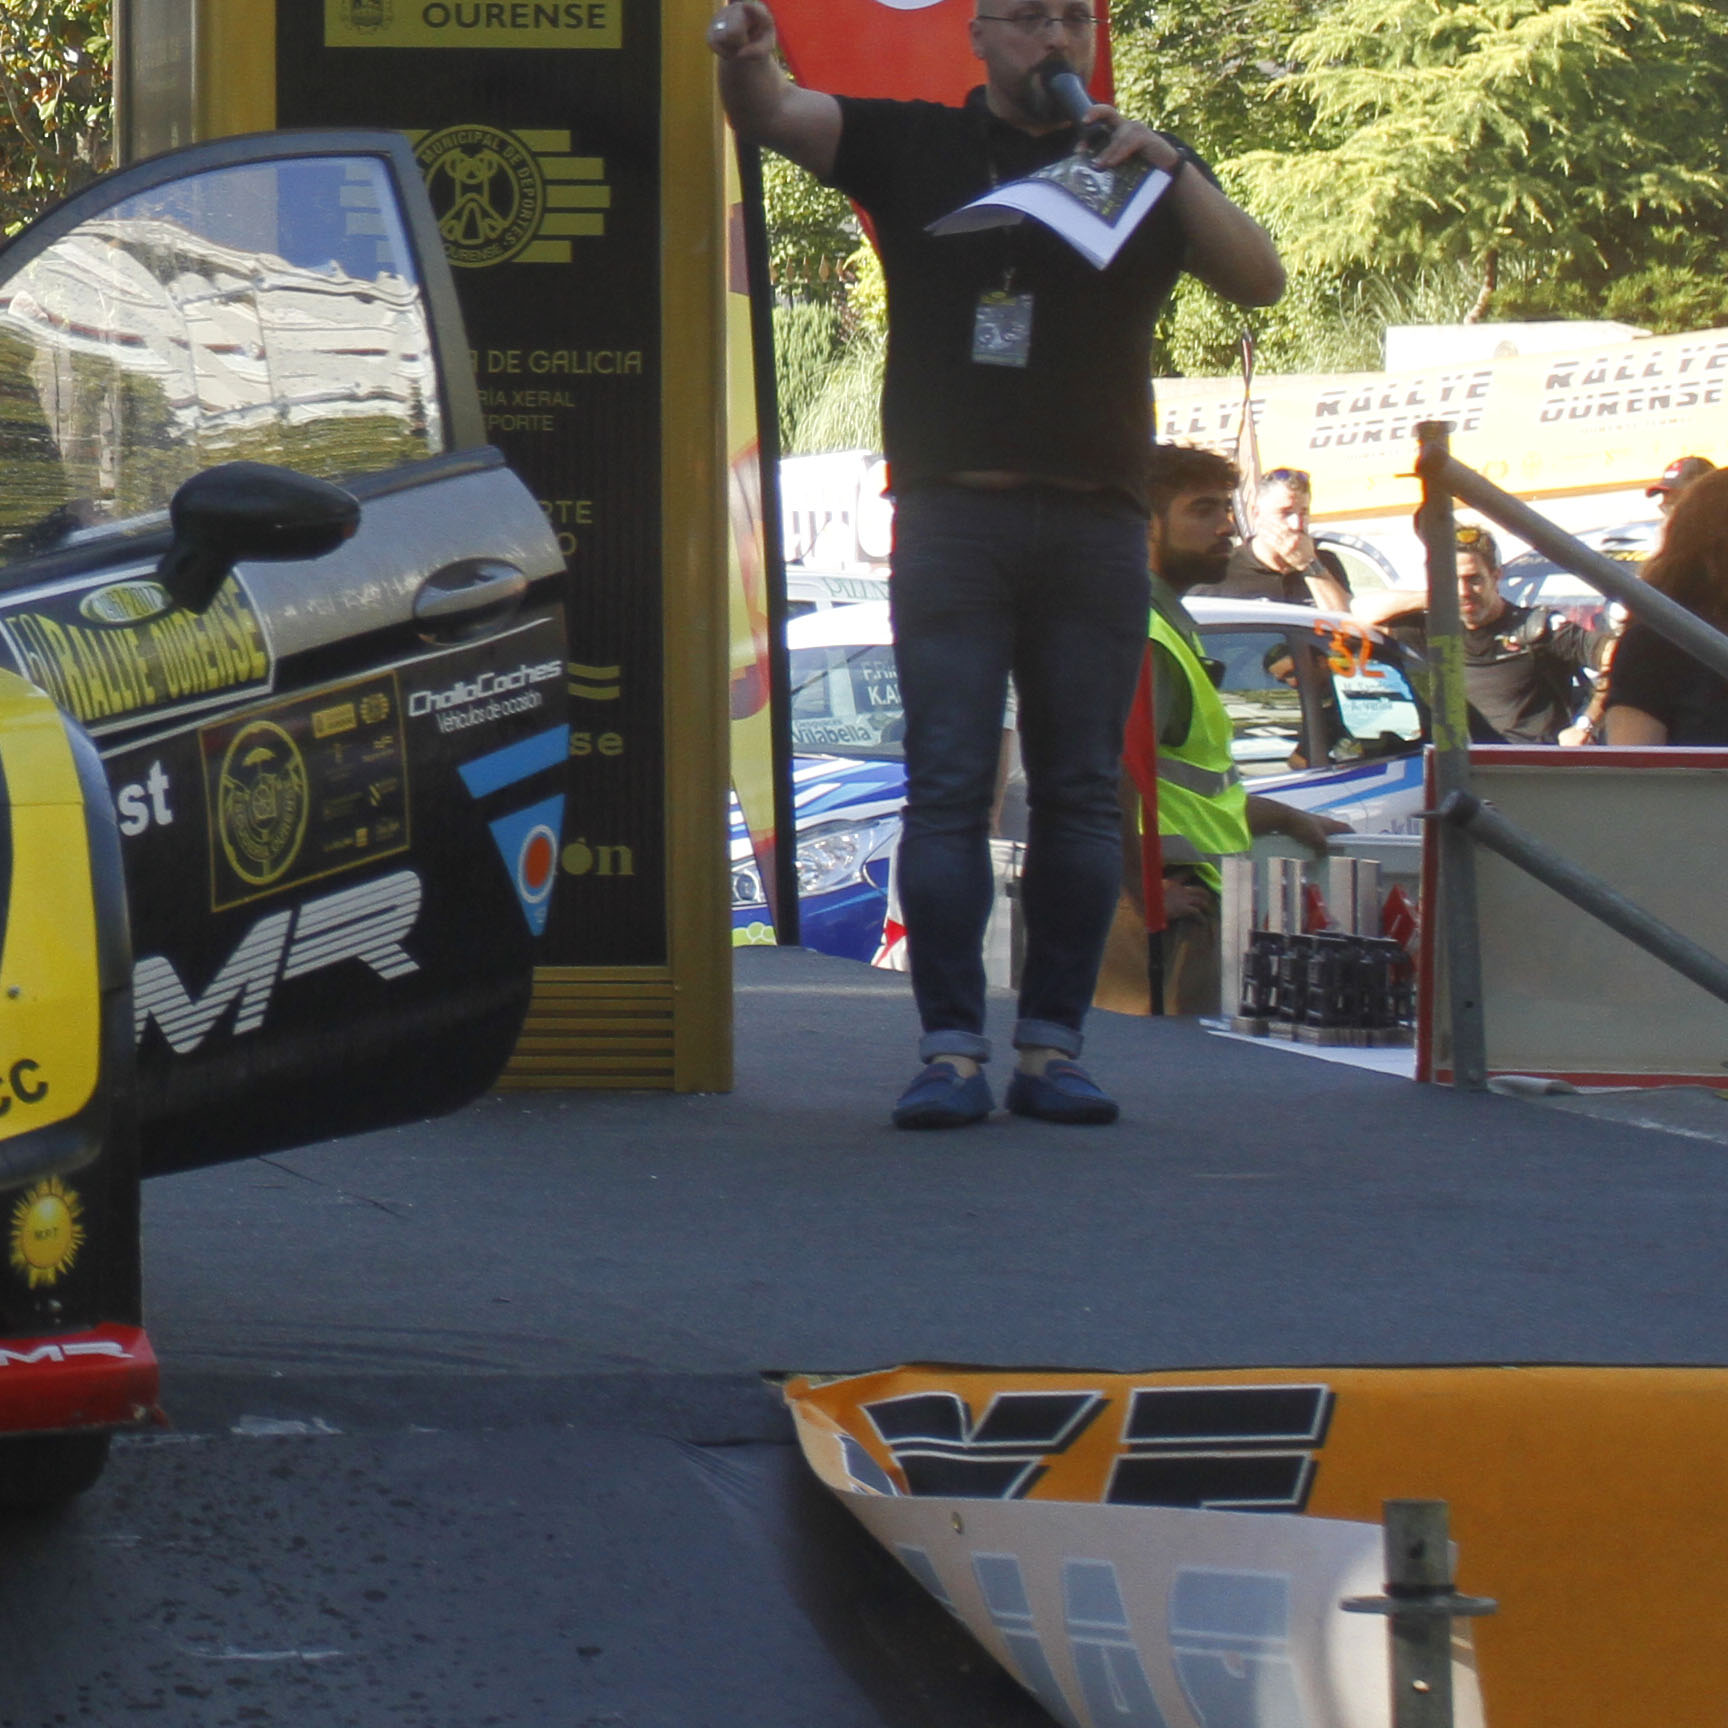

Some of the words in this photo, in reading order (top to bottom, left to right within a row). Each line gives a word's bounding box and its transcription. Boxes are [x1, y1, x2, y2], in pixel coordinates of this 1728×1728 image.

[420, 2, 606, 30] OURENSE
[420, 131, 501, 165] MUNICIPAL
[502, 145, 522, 166] DE
[503, 167, 536, 246] DEPORTES
[487, 350, 521, 373] DE
[528, 350, 643, 374] GALICIA
[511, 390, 576, 408] XERAL
[1315, 370, 1494, 419] RALLYE
[487, 414, 555, 431] PORTE
[133, 869, 423, 1054] MR
